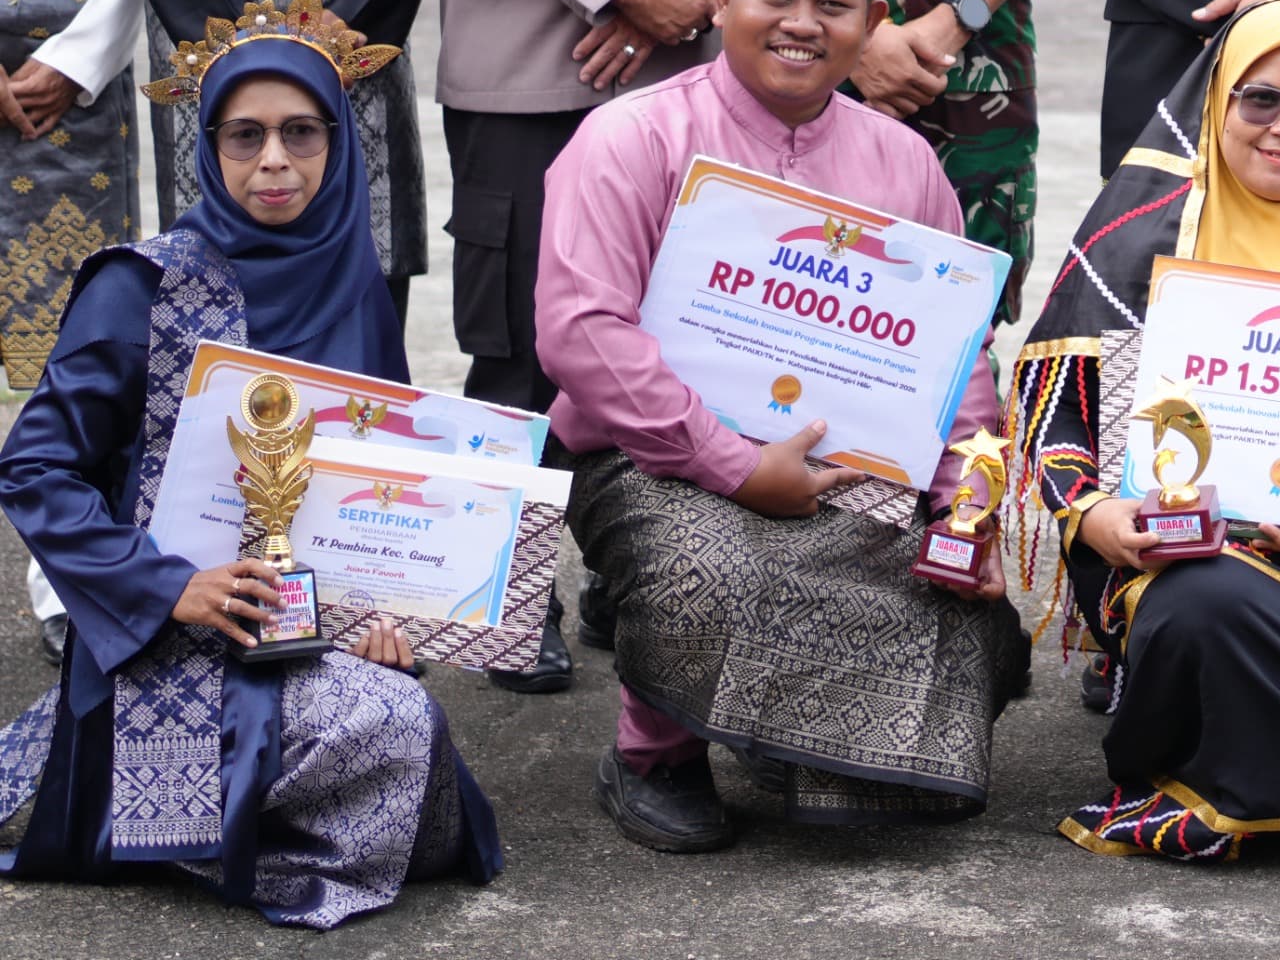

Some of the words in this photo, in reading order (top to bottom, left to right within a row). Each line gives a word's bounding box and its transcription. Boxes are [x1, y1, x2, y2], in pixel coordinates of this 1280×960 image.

[769, 246, 850, 289] JUARA
[856, 272, 873, 293] 3
[708, 260, 755, 295] RP
[761, 278, 916, 346] 1000.000
[690, 297, 722, 315] Lomba
[722, 307, 759, 326] Sekolah
[760, 319, 793, 336] Inovasi
[793, 329, 833, 351] Program
[833, 342, 883, 364] Ketahanan
[883, 357, 917, 376] Pangan
[1184, 354, 1228, 386] RP
[211, 494, 244, 508] Lomba
[224, 519, 242, 528] rang
[337, 506, 433, 531] SERTIFIKAT
[1157, 520, 1185, 529] JUARA
[311, 535, 327, 547] TK
[329, 538, 378, 554] Pembina
[380, 545, 404, 558] Kec.
[408, 550, 445, 567] Gaung
[936, 540, 959, 553] JUARA
[344, 564, 370, 574] Juara
